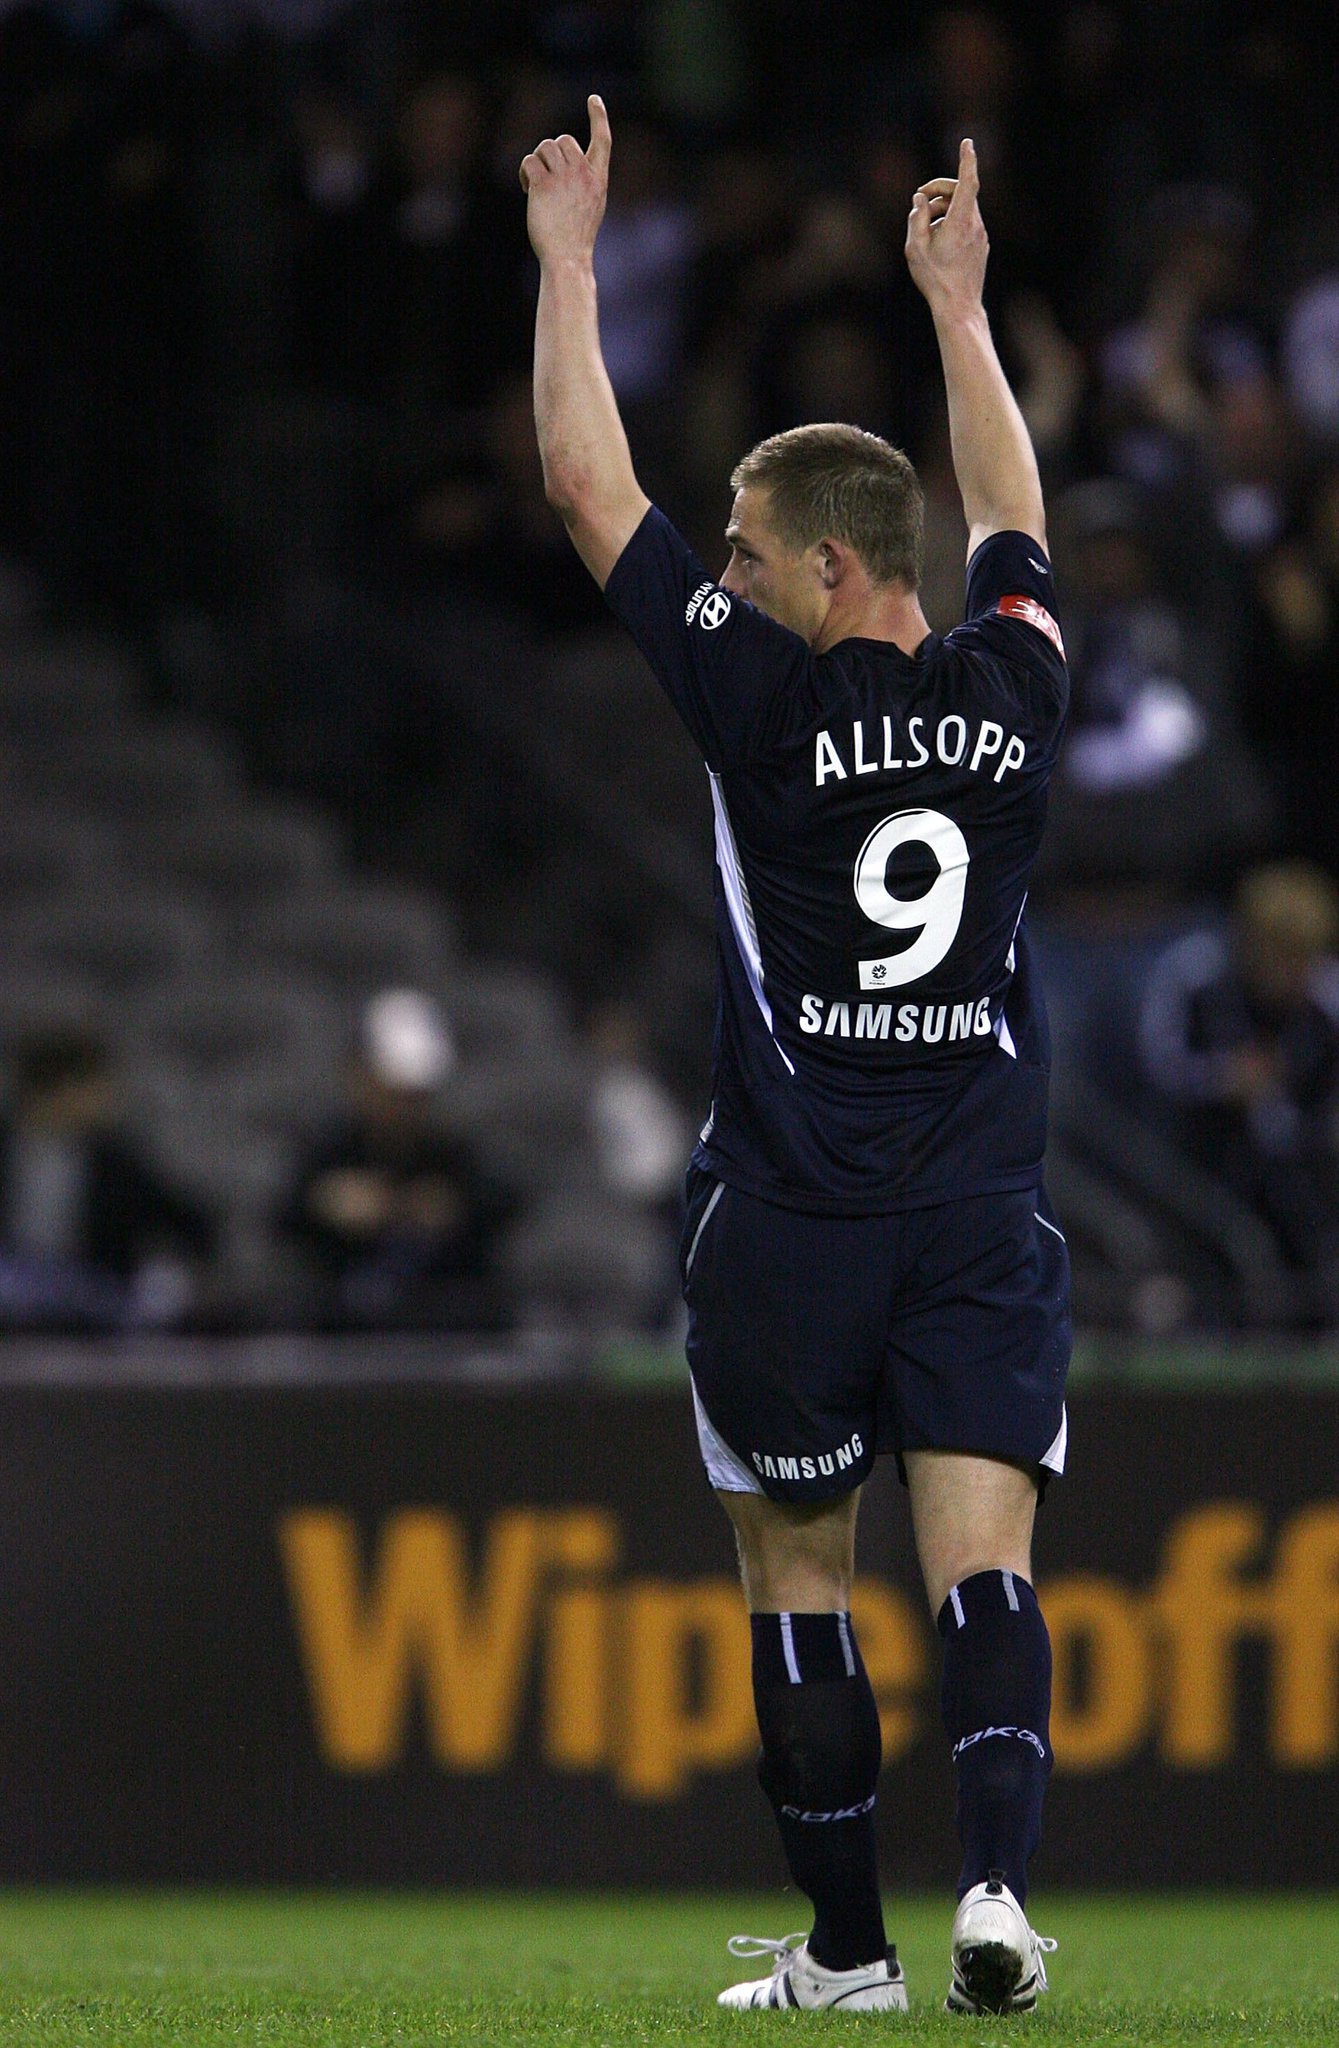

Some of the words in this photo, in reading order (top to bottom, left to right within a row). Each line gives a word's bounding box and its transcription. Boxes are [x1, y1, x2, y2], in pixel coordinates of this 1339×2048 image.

[816, 715, 1026, 786] ALLSOPP
[854, 808, 970, 990] 9
[800, 994, 992, 1043] SAMSUNG
[752, 1433, 863, 1480] SAMSUNG
[1040, 1504, 1339, 1768] off
